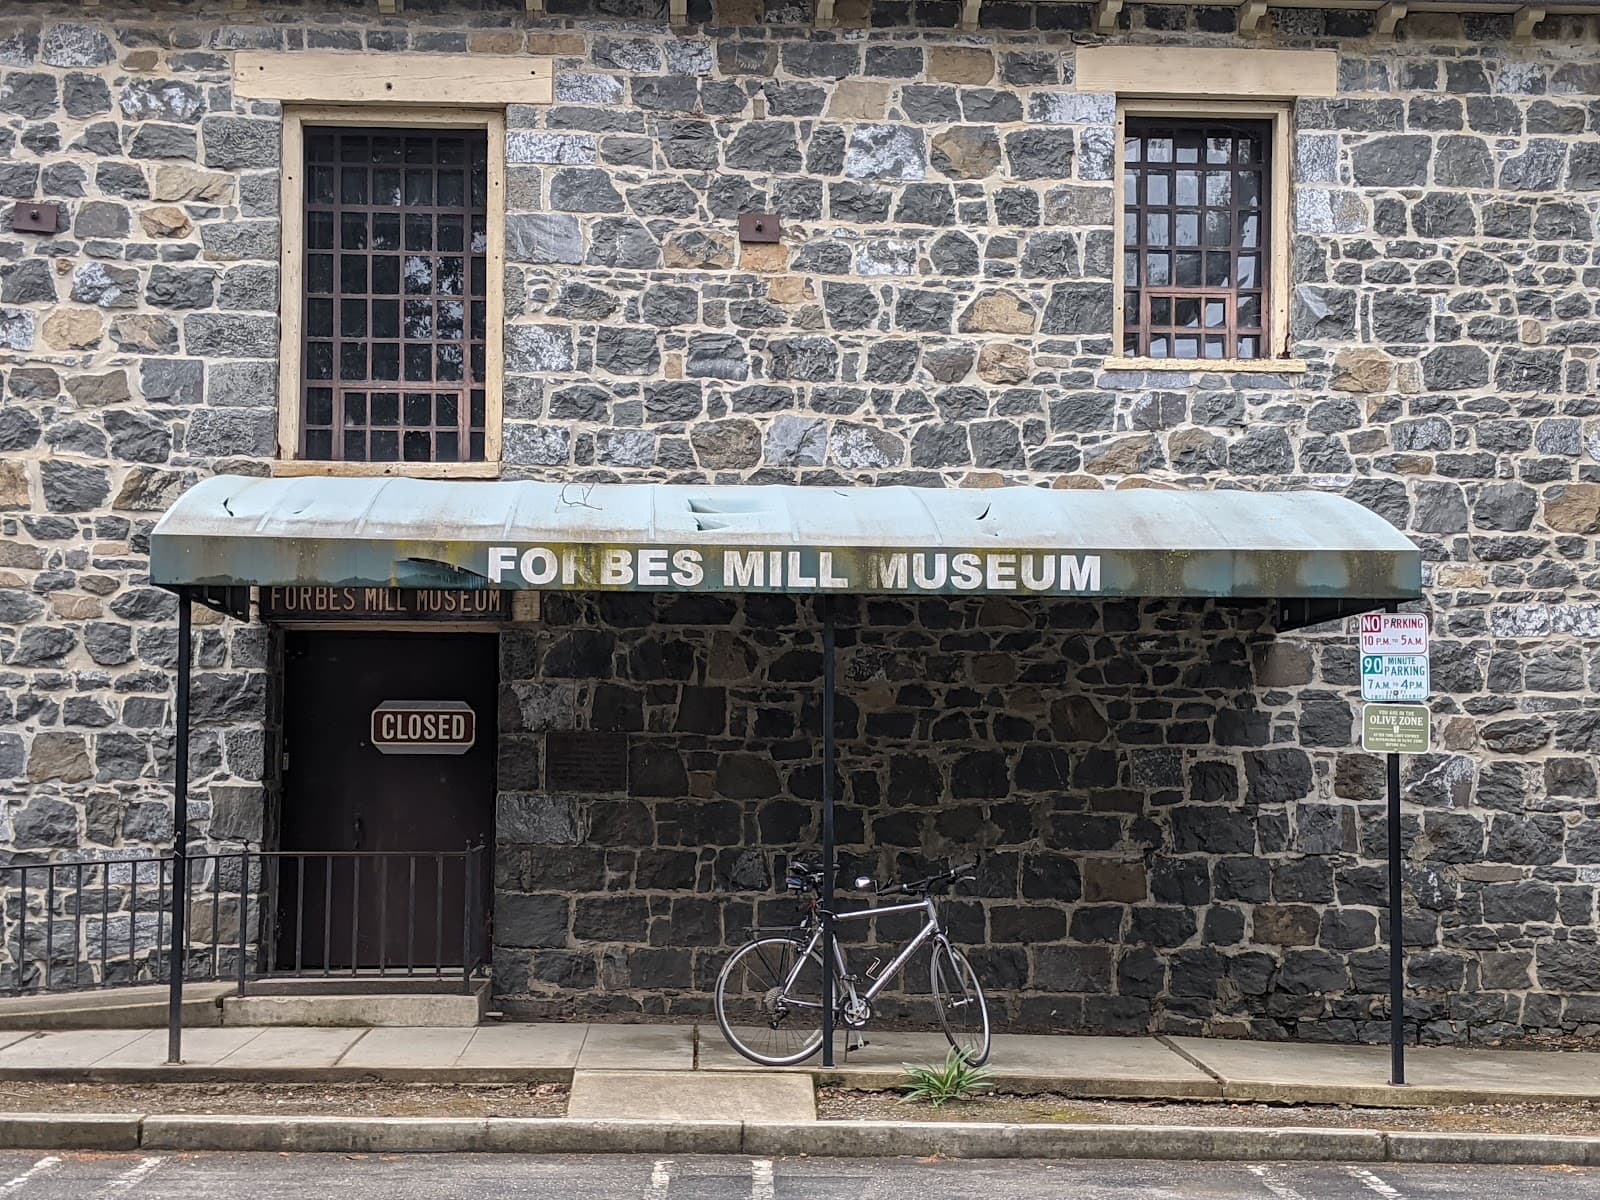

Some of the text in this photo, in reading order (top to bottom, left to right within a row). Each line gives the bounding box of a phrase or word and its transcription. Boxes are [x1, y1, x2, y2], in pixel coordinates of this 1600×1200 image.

[487, 547, 1101, 592] FORBES MILL MUSEUM
[271, 587, 500, 613] FORBES MILL MUSEUM
[1362, 615, 1424, 632] NO PARKING
[1363, 635, 1374, 646] 10
[1364, 657, 1382, 673] 90
[1387, 656, 1416, 665] MINUTE
[1384, 665, 1425, 676] PARKING
[381, 713, 466, 740] CLOSED
[1369, 715, 1424, 727] OLIVE ZONE
